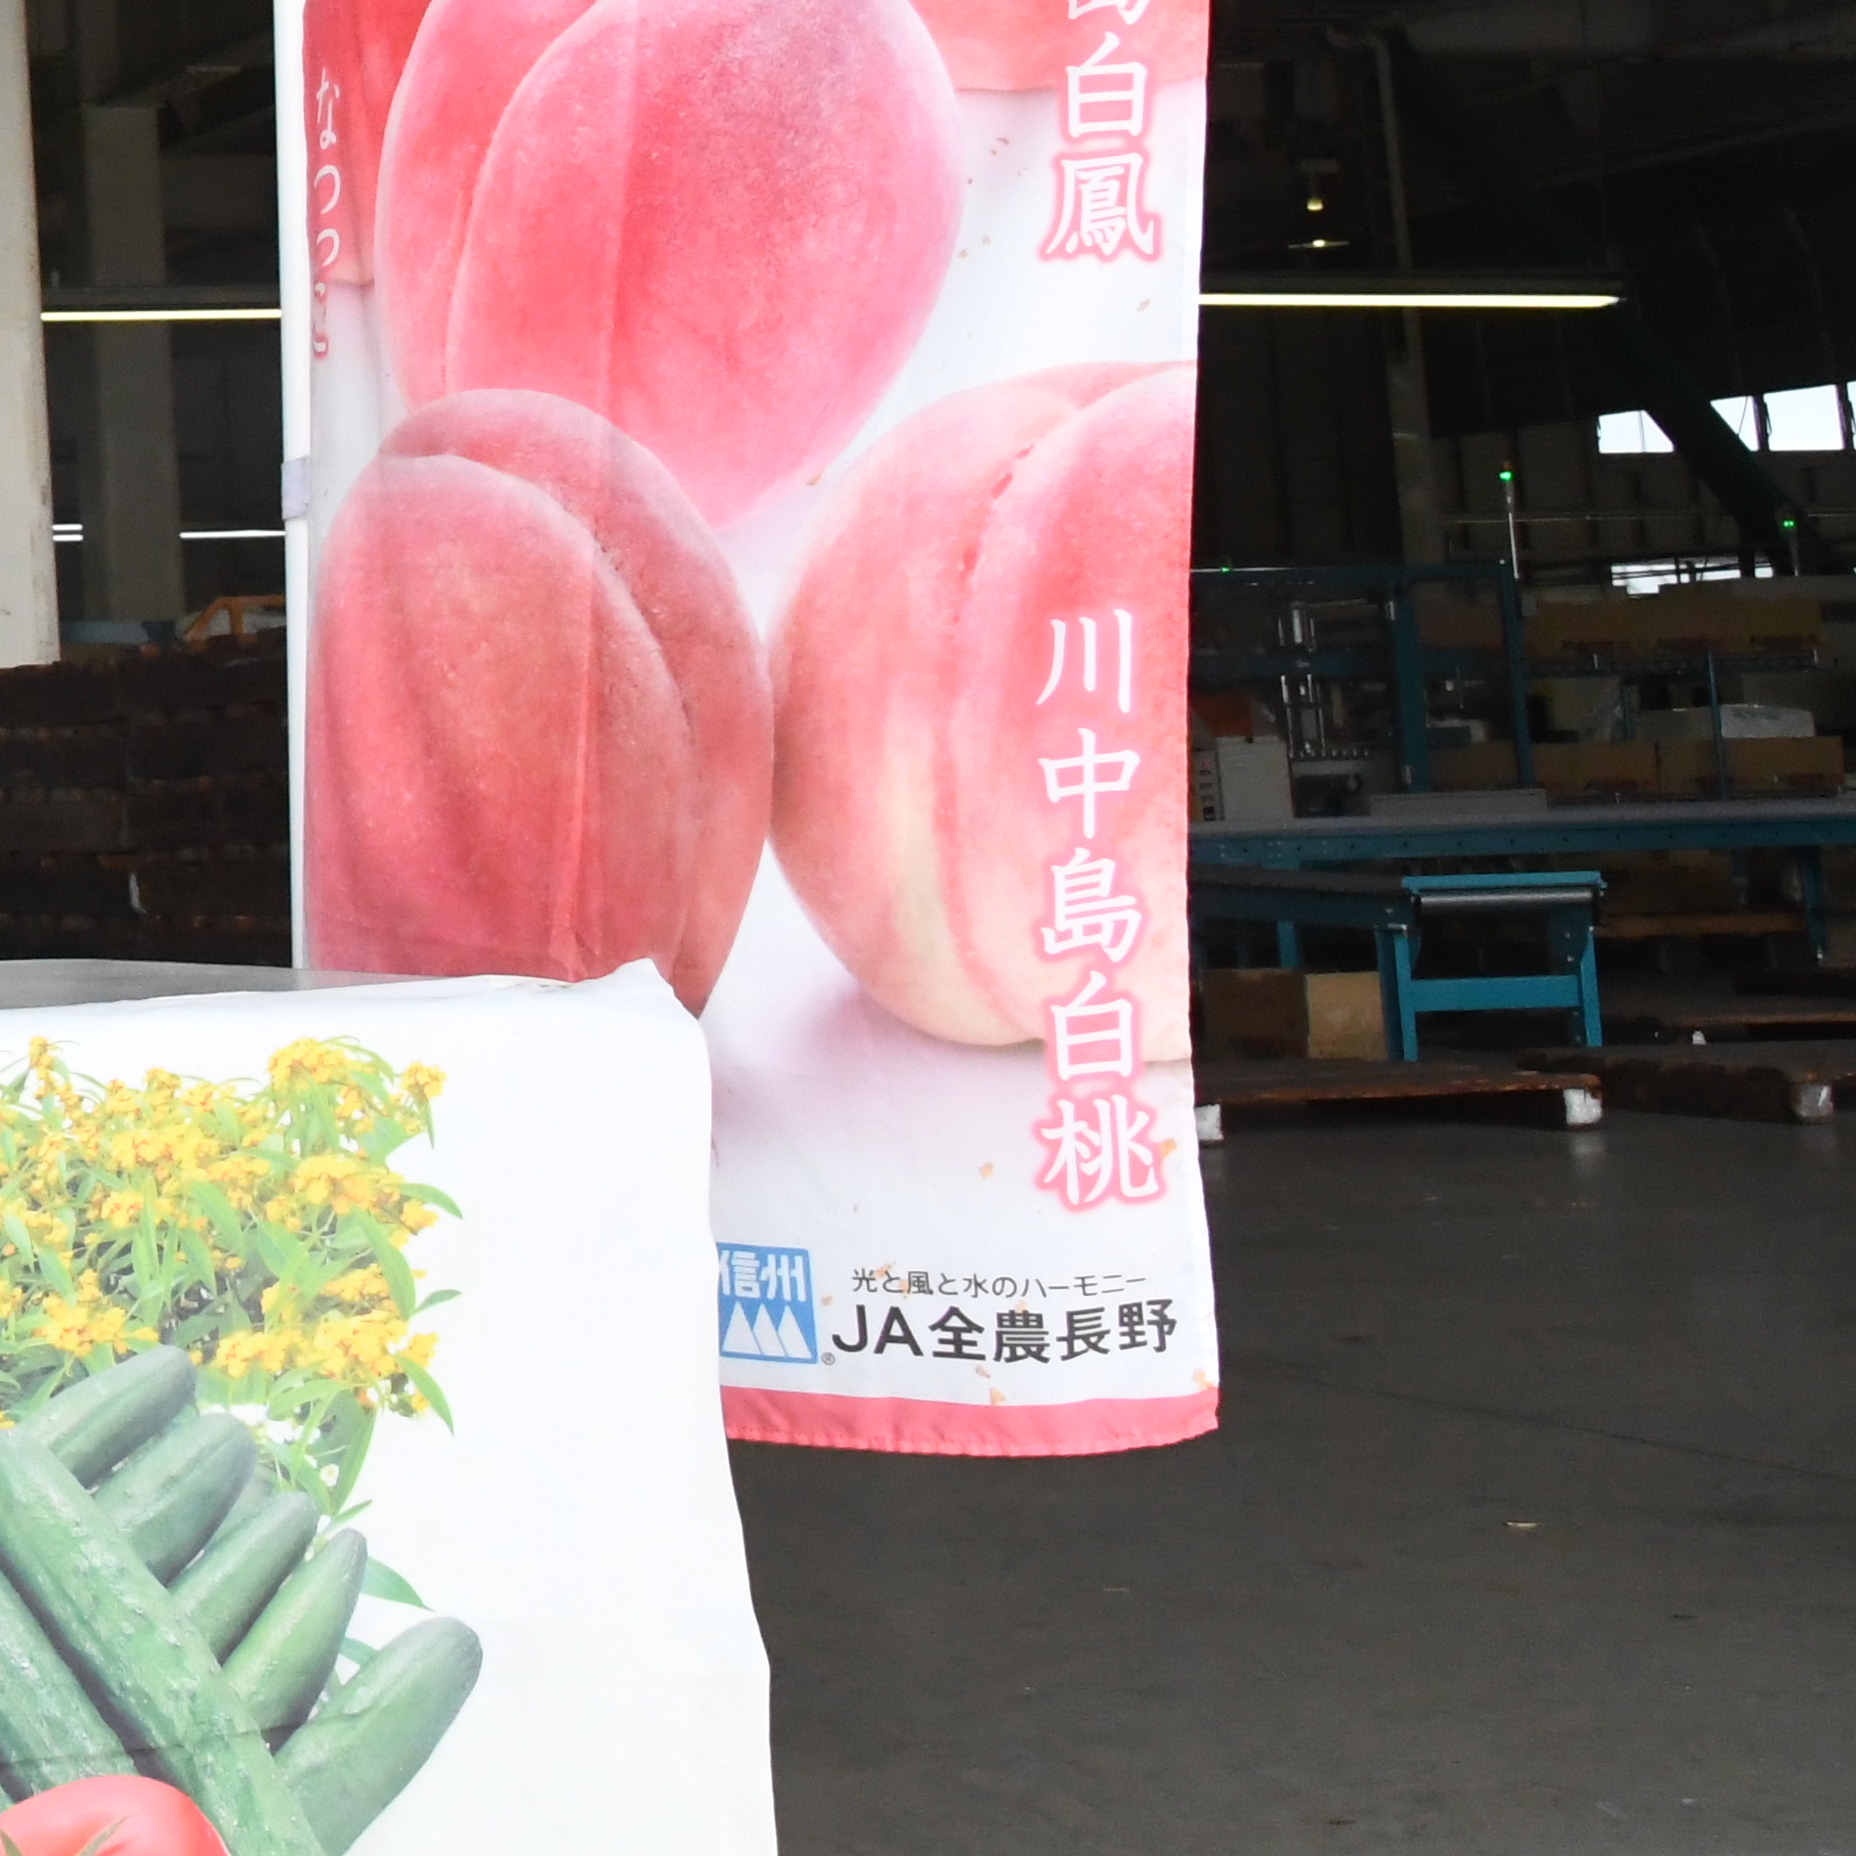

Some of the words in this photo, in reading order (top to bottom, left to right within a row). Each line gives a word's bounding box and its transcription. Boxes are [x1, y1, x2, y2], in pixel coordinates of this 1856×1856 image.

[1034, 609, 1161, 1204] 川中島白桃
[718, 1249, 807, 1302] 信州
[851, 1268, 1147, 1299] 光と風と水のハーモニー
[831, 1298, 1177, 1364] JA全農長野
